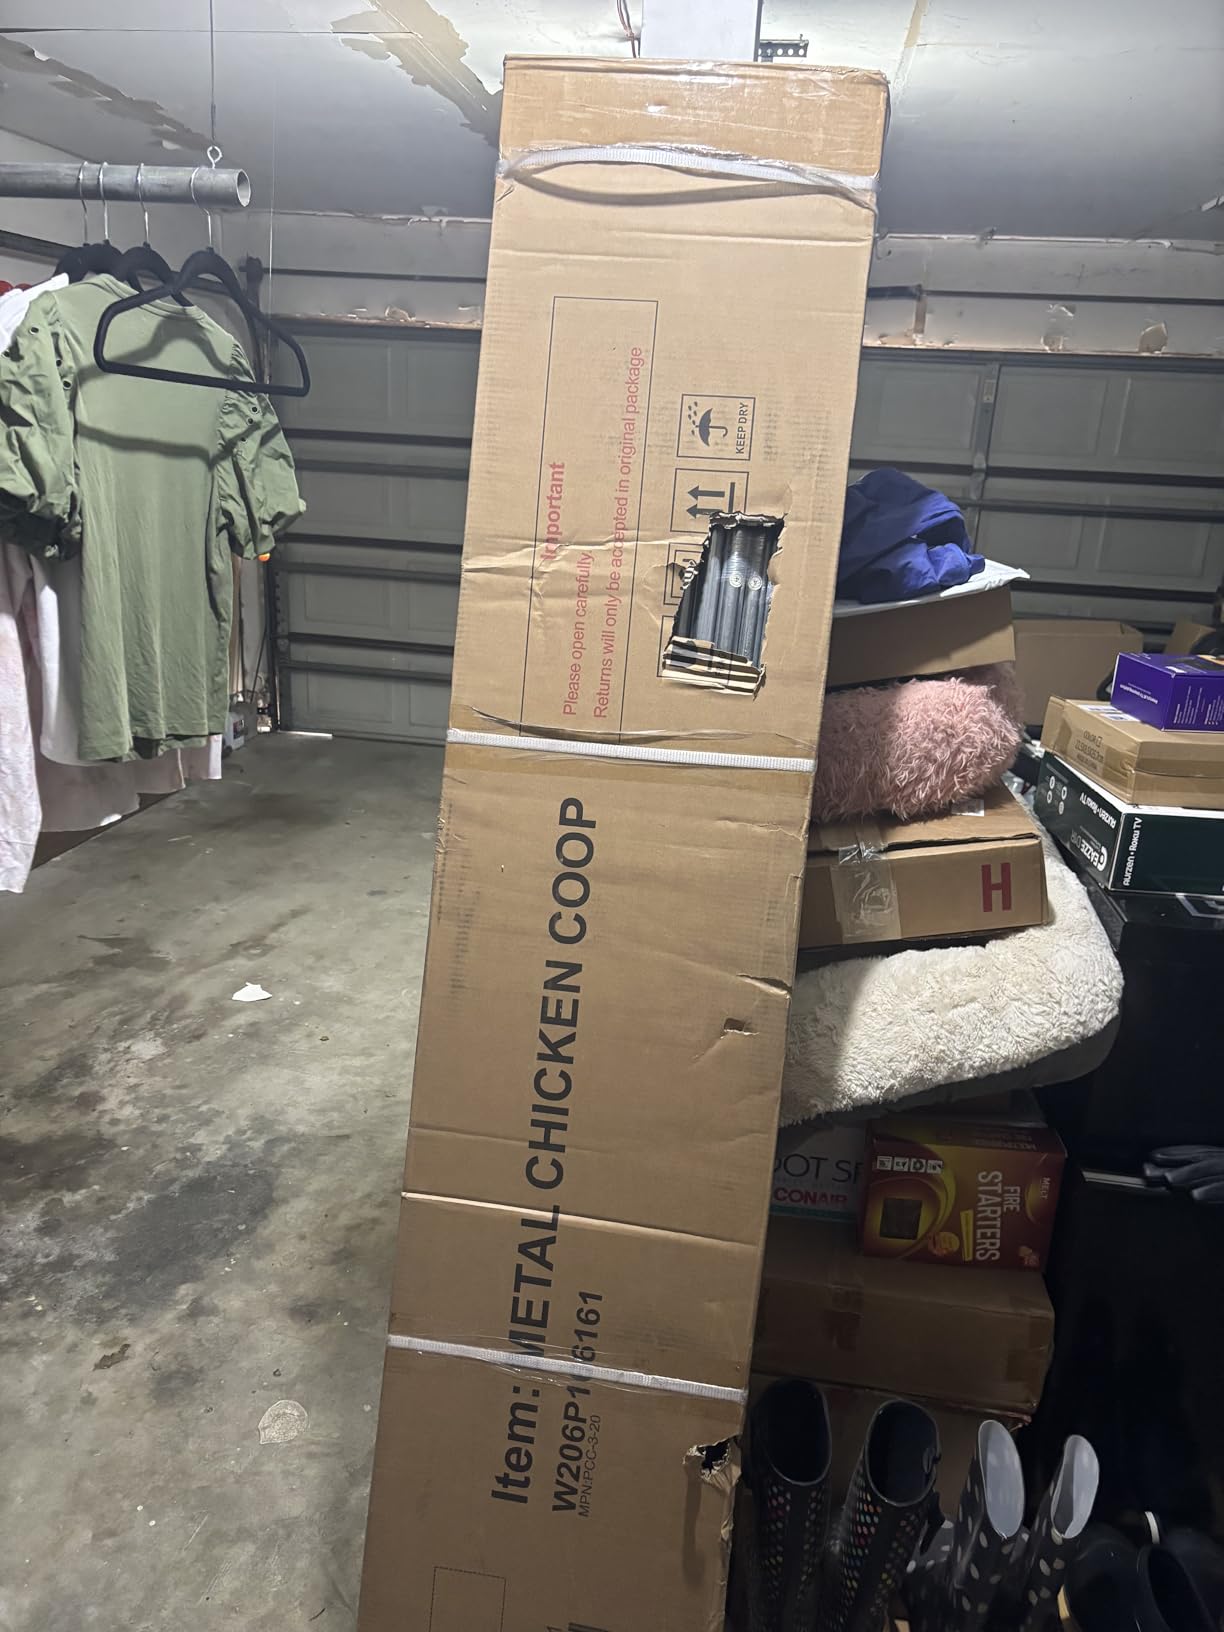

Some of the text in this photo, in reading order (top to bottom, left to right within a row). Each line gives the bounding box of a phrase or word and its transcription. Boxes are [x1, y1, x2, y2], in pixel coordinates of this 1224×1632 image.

[735, 402, 749, 454] KEEP DRY
[540, 462, 565, 560] Important
[593, 346, 645, 718] Returns will only be accepted in original package
[562, 663, 582, 716] Please
[572, 621, 587, 660] open
[1132, 817, 1143, 830] TV
[548, 797, 598, 945] COOP
[981, 862, 1012, 913] H
[525, 959, 584, 1191] CHICKEN
[774, 1153, 829, 1180] OT
[774, 1187, 848, 1206] CONAIR
[1003, 1186, 1021, 1213] FIRE
[975, 1170, 1003, 1262] STARTERS
[491, 1385, 541, 1504] Item:
